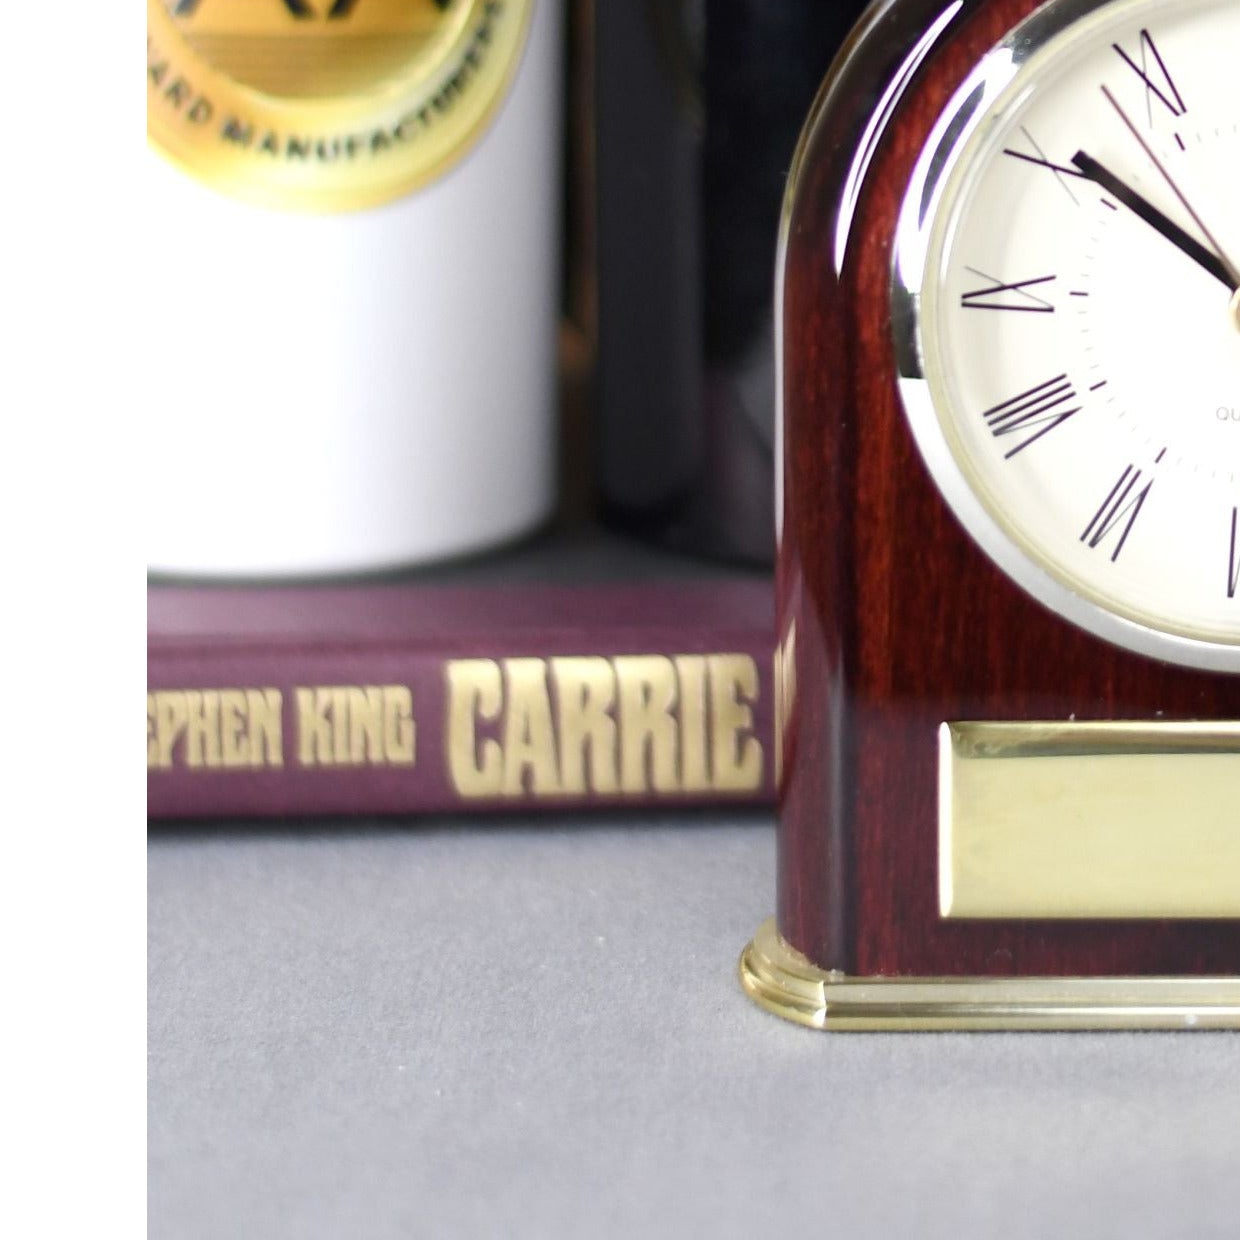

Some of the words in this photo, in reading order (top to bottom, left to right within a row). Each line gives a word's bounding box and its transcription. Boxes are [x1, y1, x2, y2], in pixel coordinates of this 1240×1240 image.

[147, 34, 215, 122] ARD
[1112, 28, 1188, 129] XI
[960, 266, 1057, 314] IX
[982, 372, 1083, 460] VIII
[1079, 463, 1154, 563] VII
[294, 685, 416, 765] KING
[447, 652, 764, 796] CARRIE
